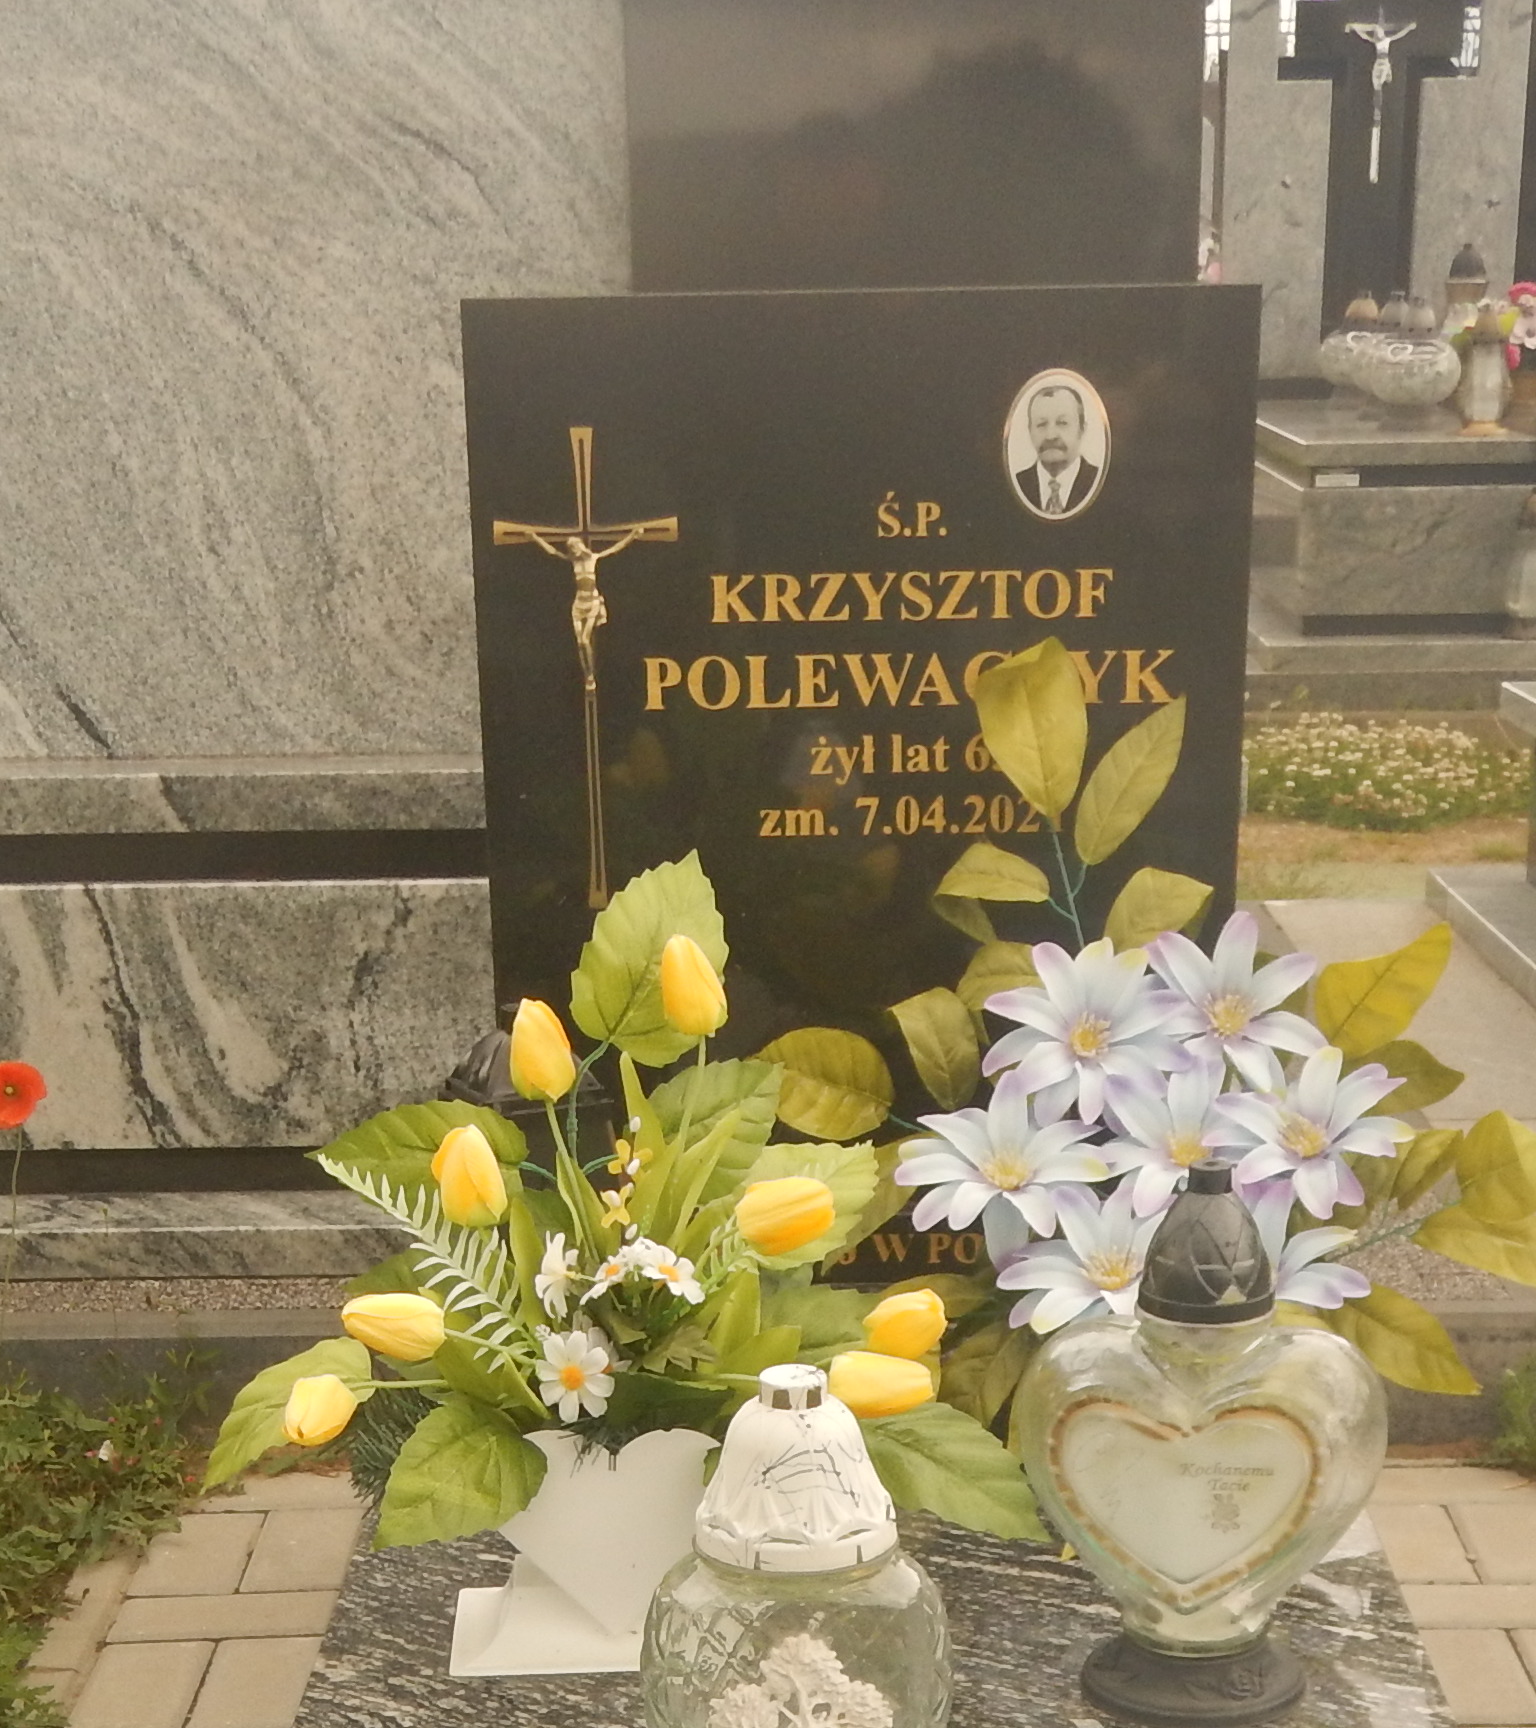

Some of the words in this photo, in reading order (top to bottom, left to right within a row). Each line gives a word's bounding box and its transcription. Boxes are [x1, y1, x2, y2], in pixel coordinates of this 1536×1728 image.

[877, 491, 948, 539] Ś.P.
[710, 567, 1114, 624] KRZYSZTOF
[643, 648, 1184, 712] POLEWACYK
[809, 733, 875, 785] żył
[891, 733, 951, 774] lat
[965, 734, 1003, 773] 6
[758, 806, 840, 838] zm.
[871, 1232, 914, 1263] W
